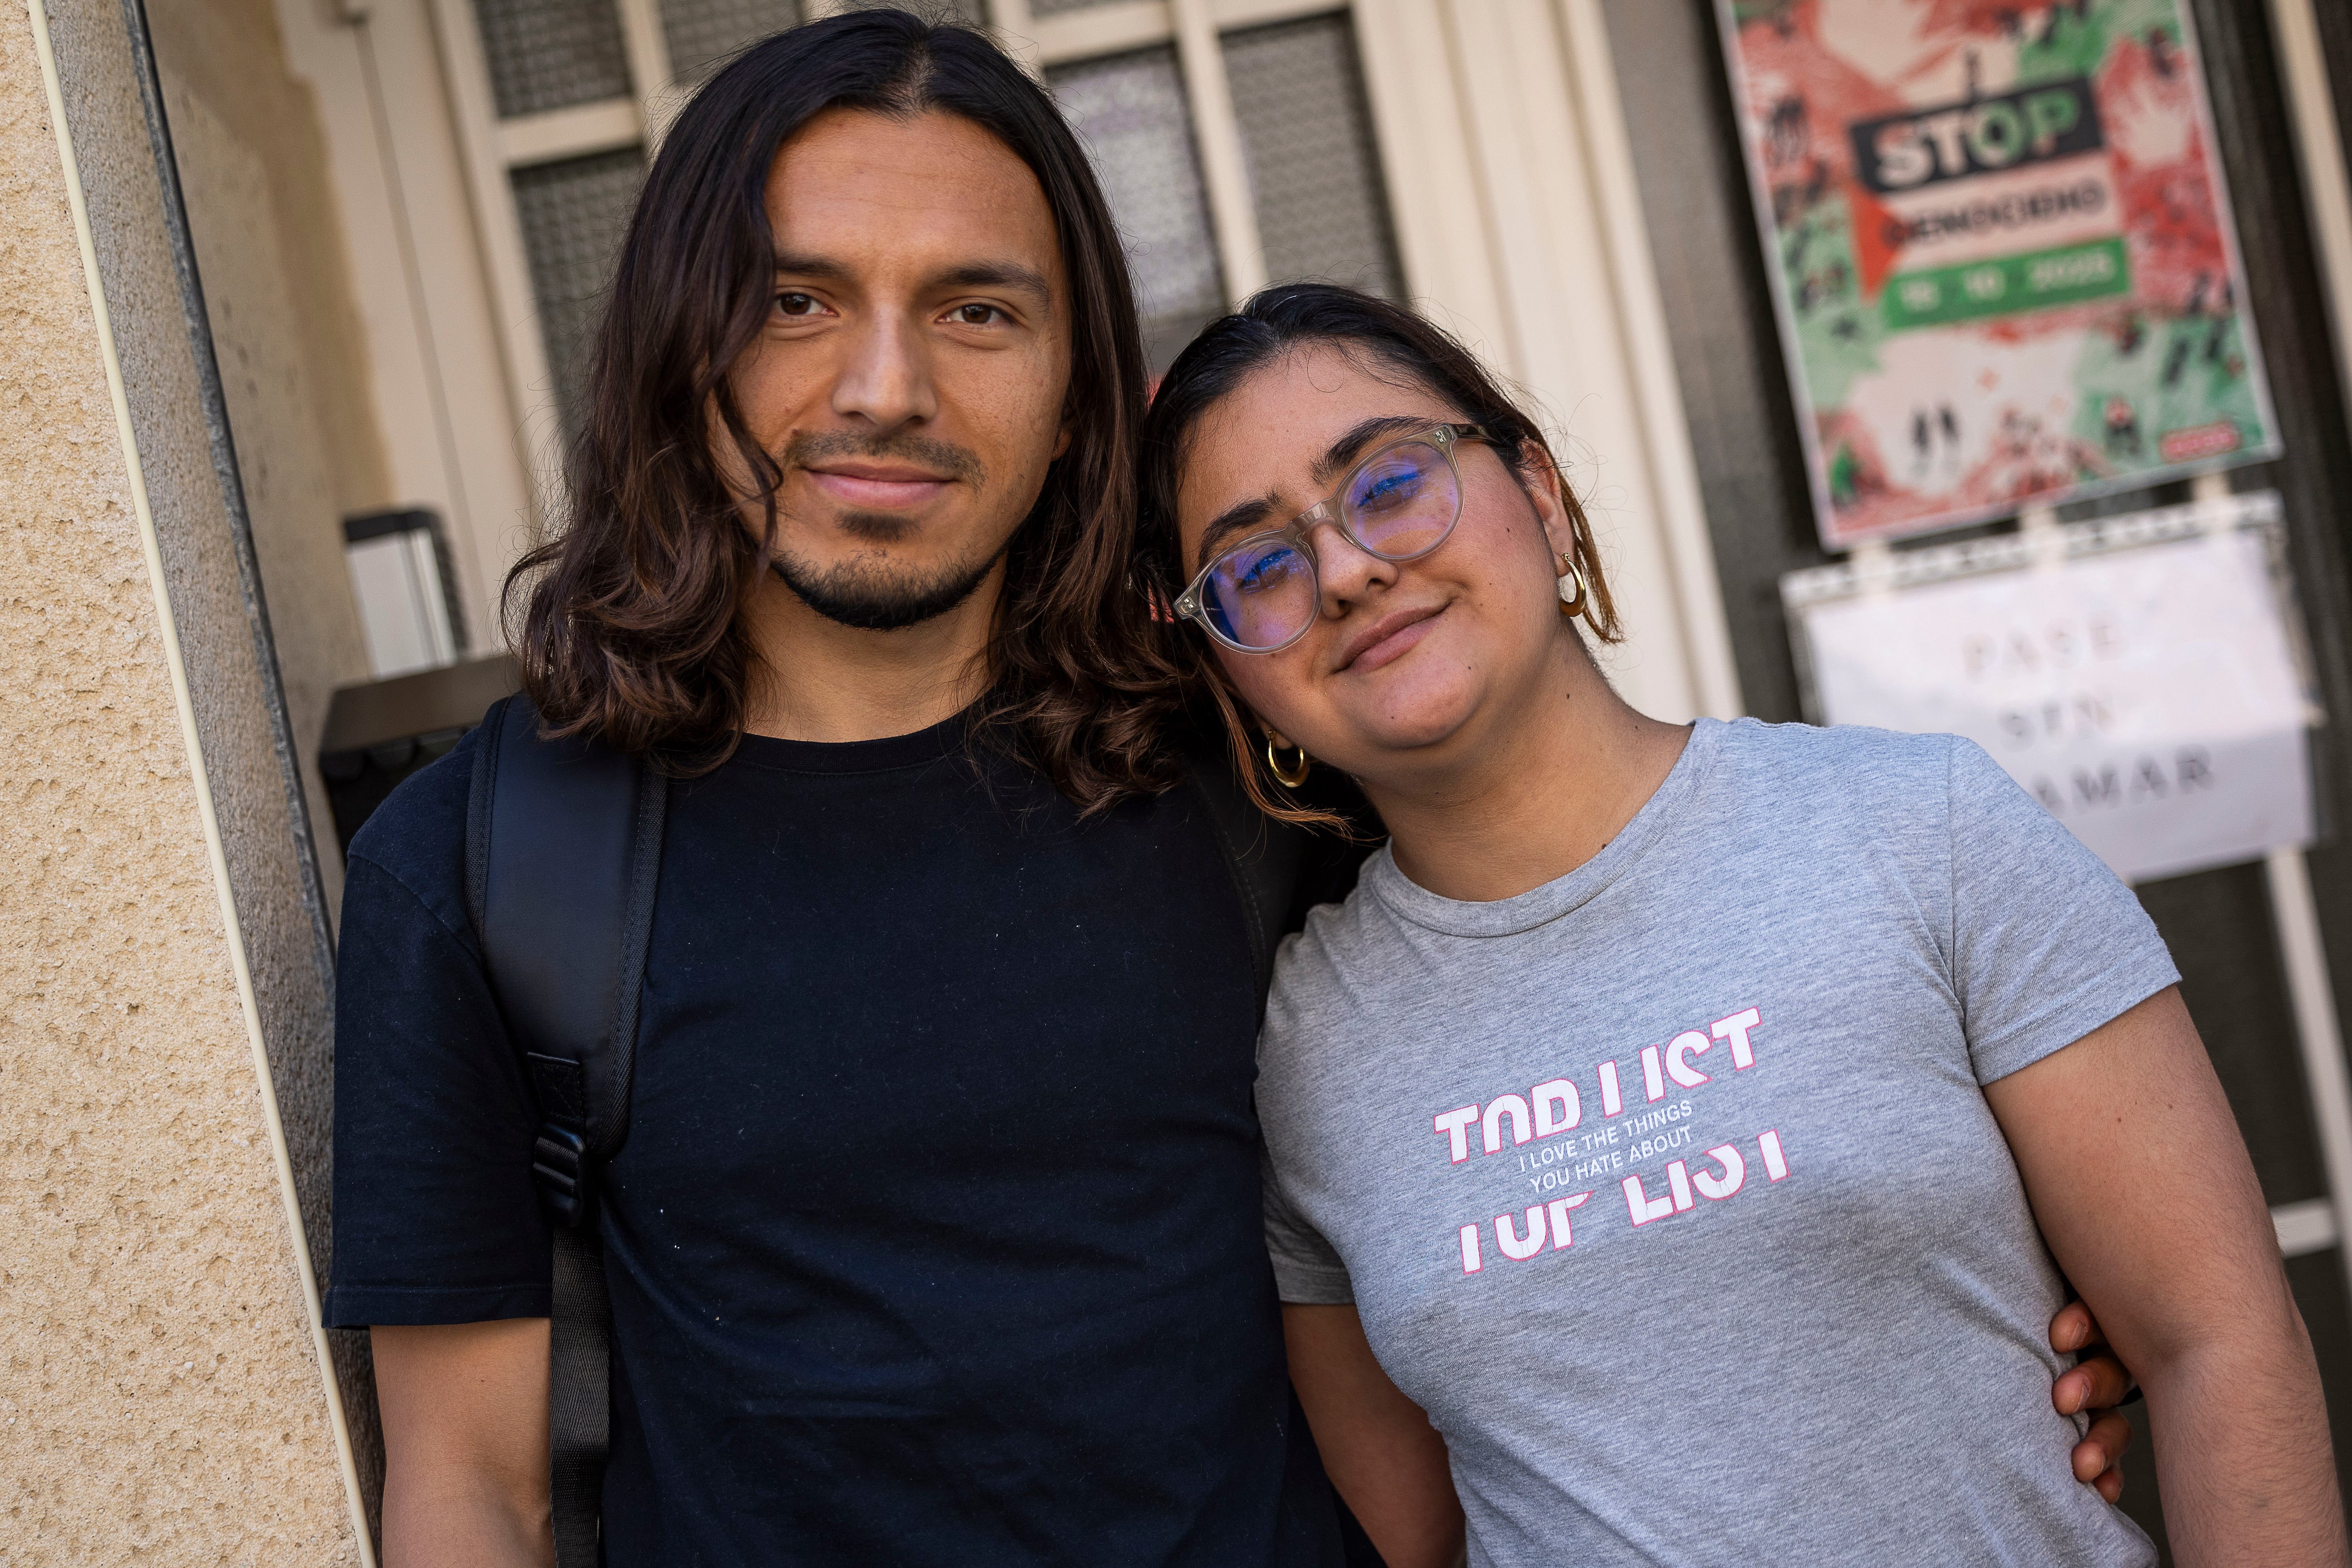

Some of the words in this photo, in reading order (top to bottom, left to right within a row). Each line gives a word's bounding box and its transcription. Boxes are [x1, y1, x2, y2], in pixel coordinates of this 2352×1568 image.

[1874, 90, 2081, 184] STOP
[1963, 614, 2126, 680] PASE
[2002, 689, 2114, 747] SIN
[1519, 1155, 1526, 1172] I
[1530, 1140, 1578, 1169] LOVE
[1581, 1126, 1619, 1151] THE
[1622, 1100, 1692, 1137] THINGS
[1530, 1167, 1570, 1193] YOU
[1575, 1150, 1623, 1181] HATE
[1629, 1125, 1692, 1163] ABOUT
